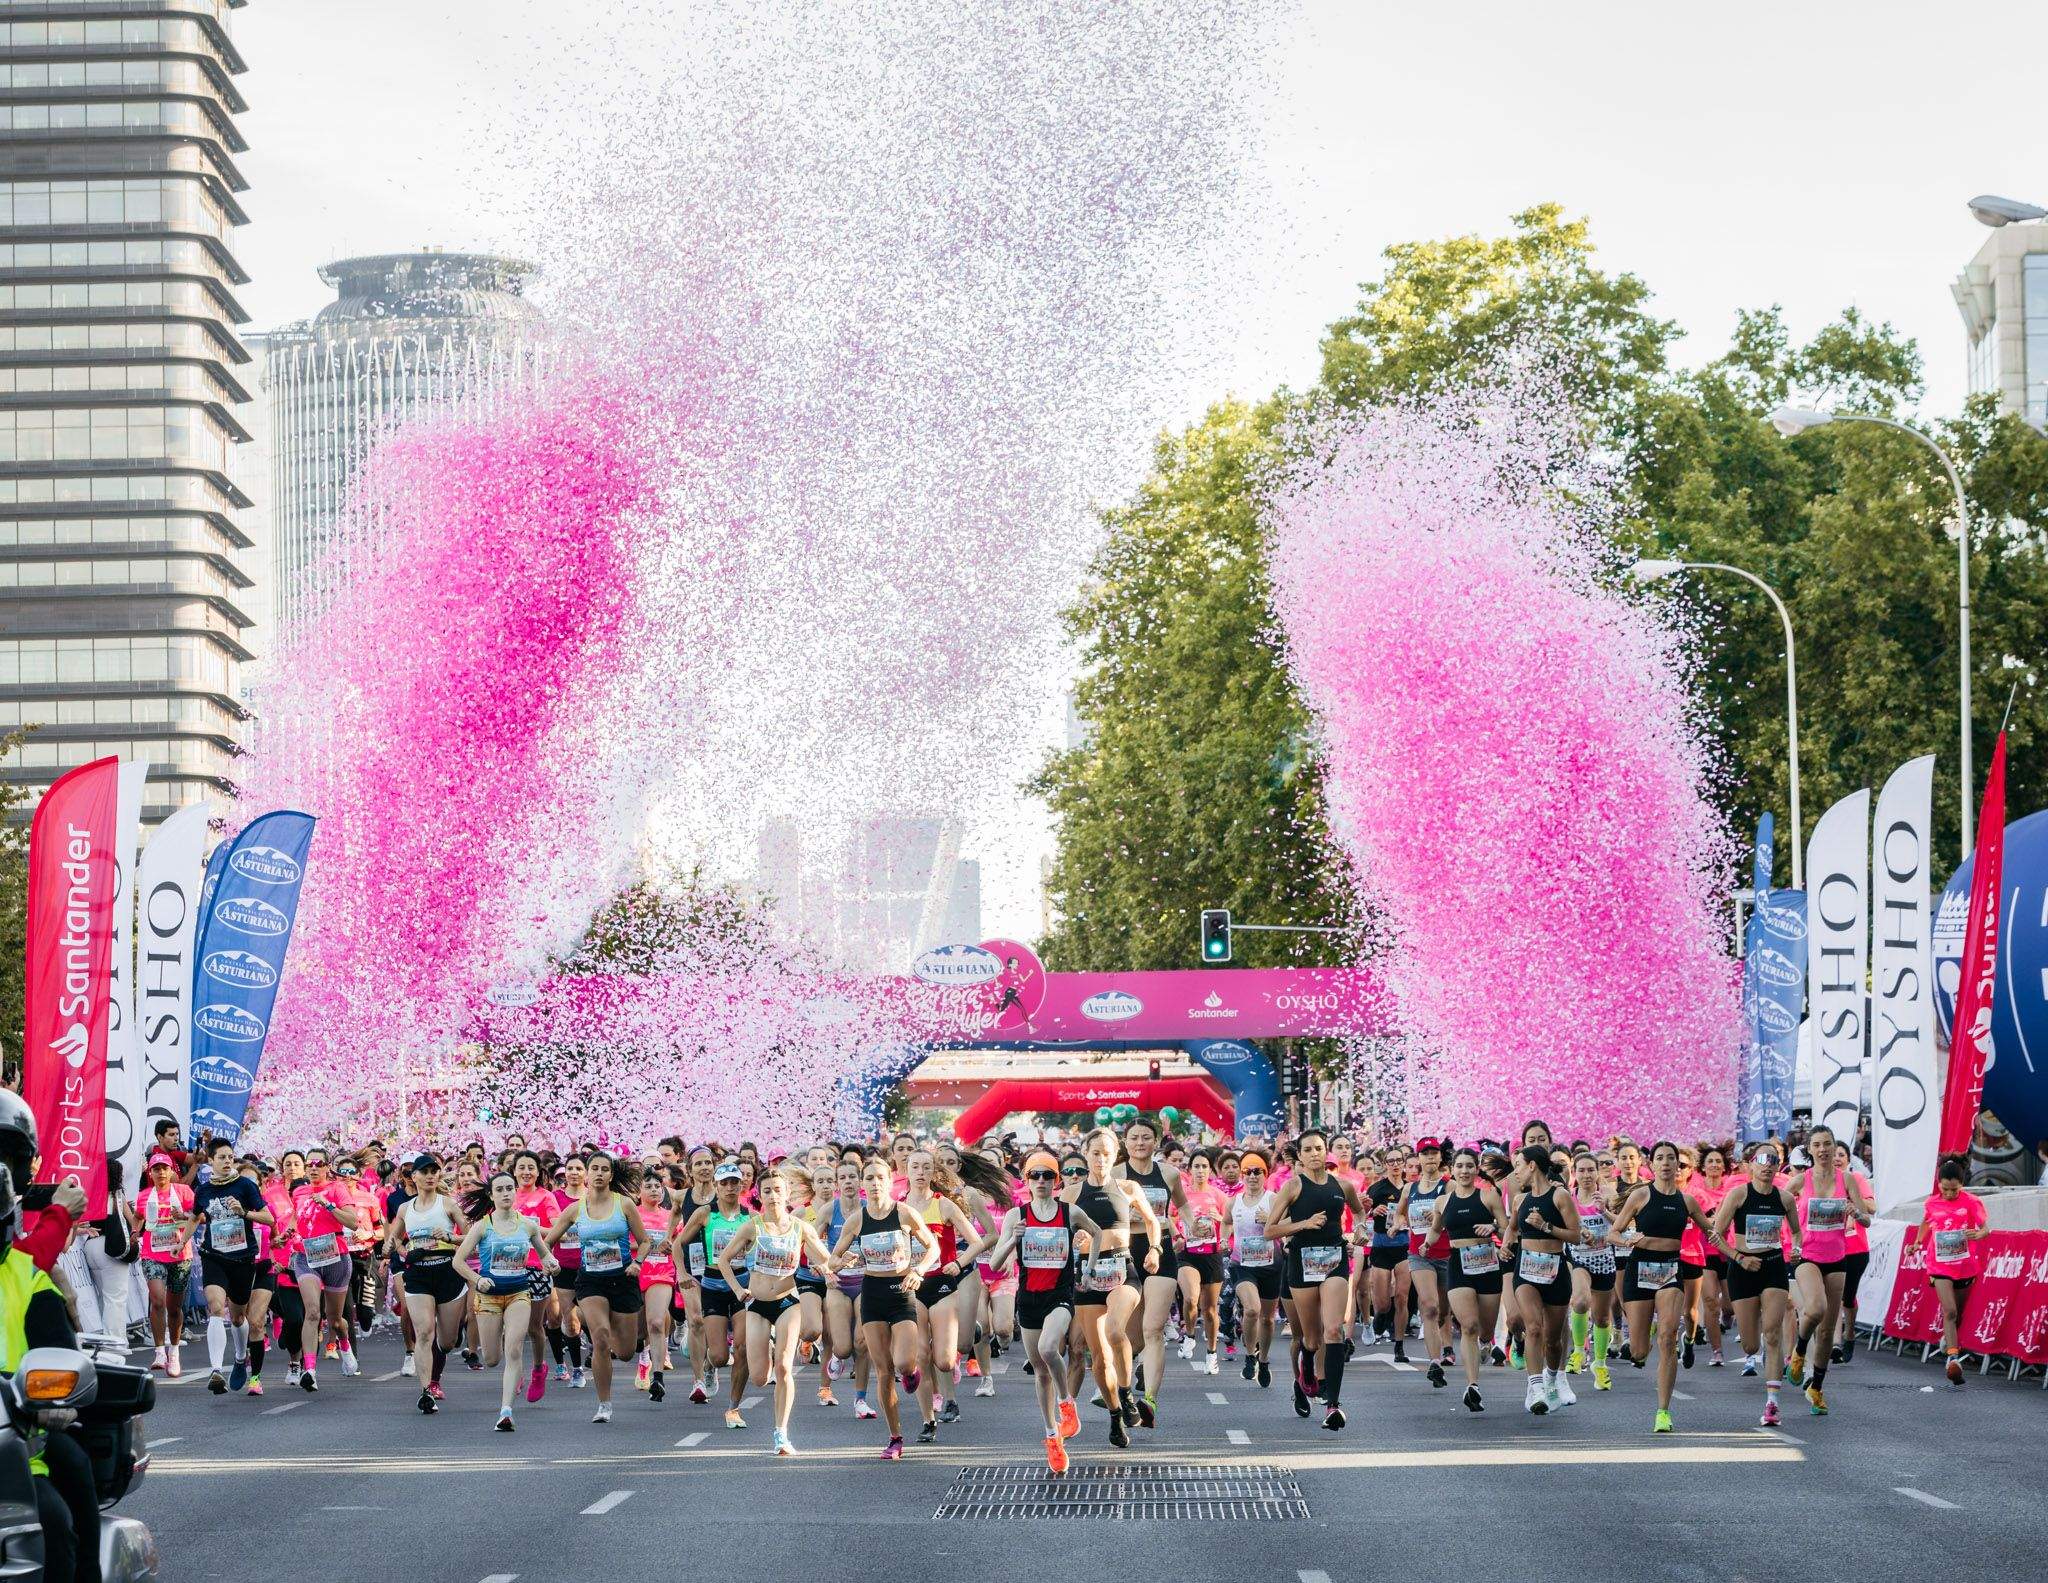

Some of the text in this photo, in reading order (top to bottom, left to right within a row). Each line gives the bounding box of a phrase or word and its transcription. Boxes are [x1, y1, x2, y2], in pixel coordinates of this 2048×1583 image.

[235, 854, 295, 880] ASTURIANA
[59, 823, 91, 1017] Santander
[220, 905, 282, 931] ASTURIANA
[208, 958, 271, 984] ASTURIANA
[1879, 821, 1926, 1130] OYSHO
[1086, 1003, 1138, 1014] ASTURIANA
[1188, 1008, 1239, 1018] Santander
[1276, 995, 1338, 1010] OYSHO
[200, 1012, 260, 1037] ASTURIANA
[192, 1065, 248, 1089] ASTURIANA
[1097, 1090, 1141, 1100] Santander
[362, 1275, 376, 1308] NIKE
